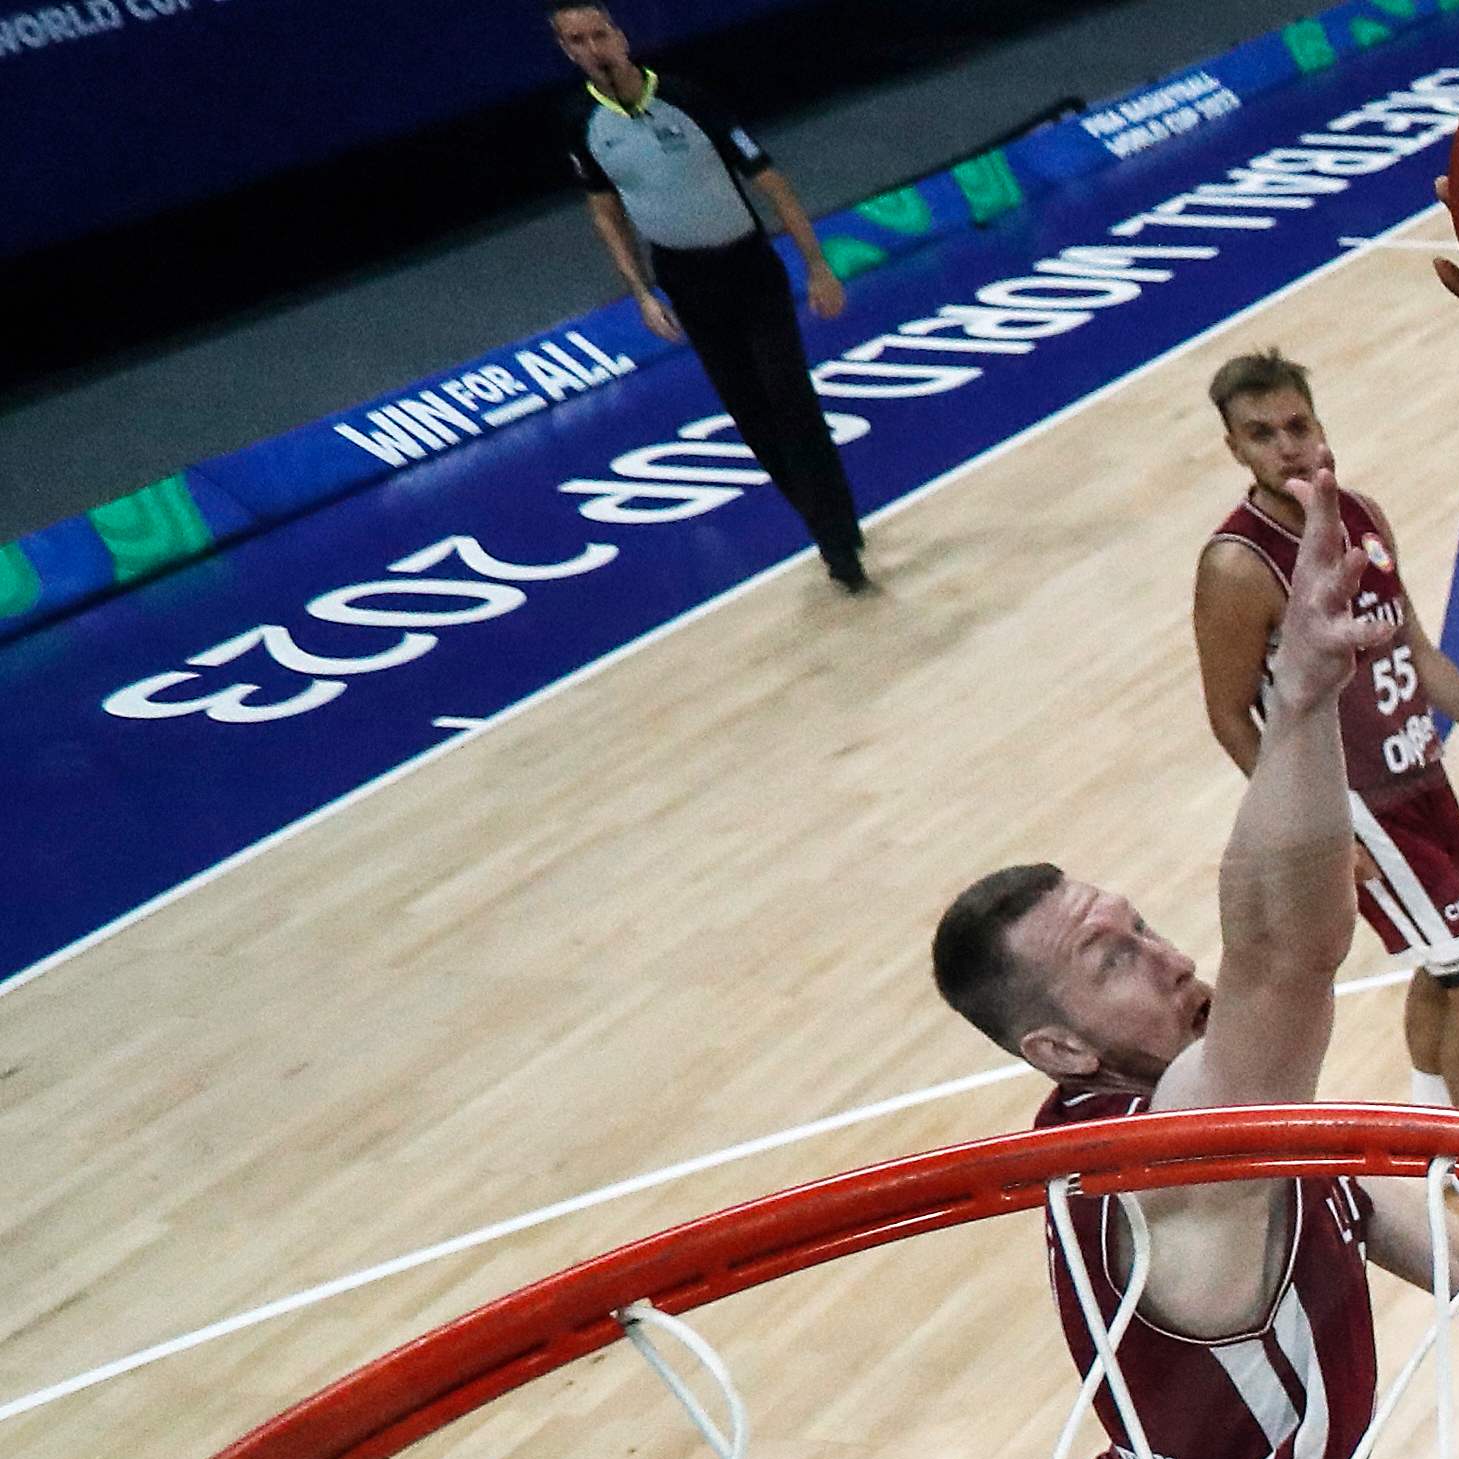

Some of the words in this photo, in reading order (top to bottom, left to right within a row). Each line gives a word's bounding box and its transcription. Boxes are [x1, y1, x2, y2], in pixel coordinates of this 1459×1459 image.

[810, 245, 1220, 399] WORLD
[333, 390, 484, 468] WIN
[440, 364, 528, 411] FOR
[514, 330, 638, 401] ALL
[102, 534, 620, 725] 2023
[1371, 645, 1419, 716] 55
